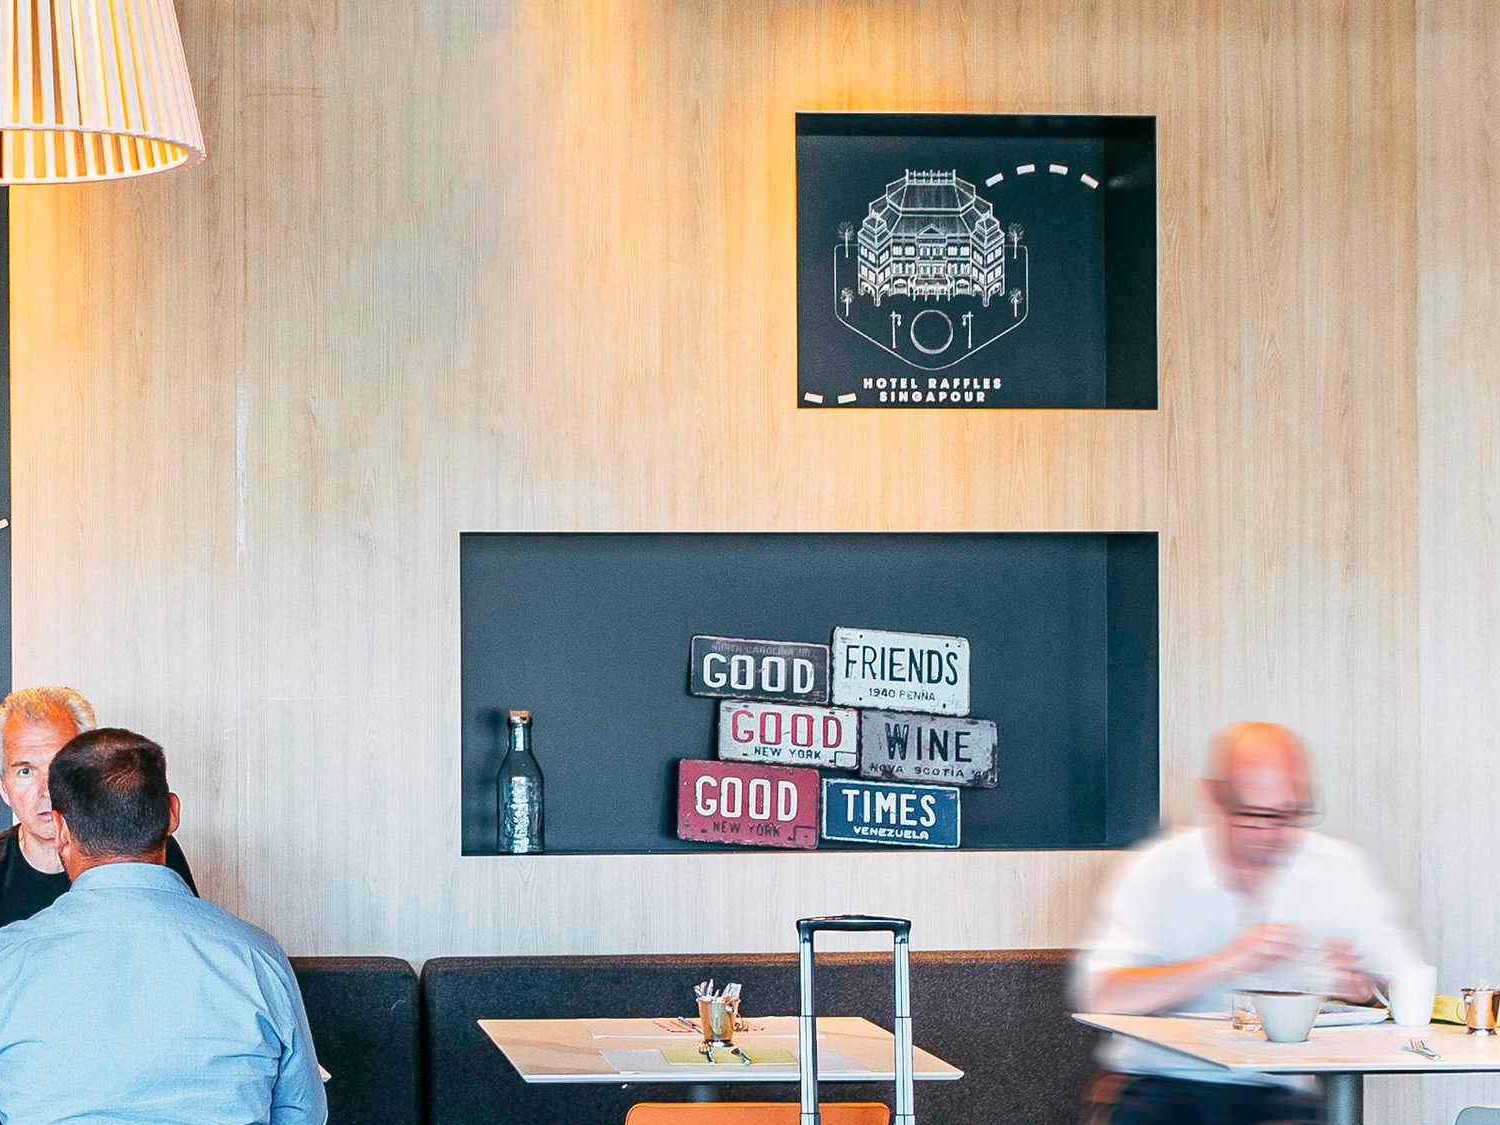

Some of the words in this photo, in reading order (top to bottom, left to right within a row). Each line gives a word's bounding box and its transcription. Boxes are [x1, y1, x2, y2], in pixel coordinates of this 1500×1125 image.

[863, 378, 918, 389] HOTEL
[928, 378, 1002, 389] RAFFLES
[879, 391, 986, 403] SINGAPOUR
[703, 652, 815, 694] GOOD
[845, 644, 958, 686] FRIENDS
[868, 687, 896, 698] 1940
[900, 690, 936, 701] PENNA
[731, 709, 842, 748] GOOD
[885, 722, 972, 763] WINE
[754, 746, 782, 757] NEW
[789, 748, 821, 760] YORK
[870, 762, 904, 773] NOVA
[914, 766, 965, 778] SCOTIA
[695, 775, 798, 821] GOOD
[841, 788, 936, 827] TIMES
[713, 821, 740, 833] NEW
[748, 823, 781, 837] YORK
[853, 826, 929, 840] VENEZUELA
